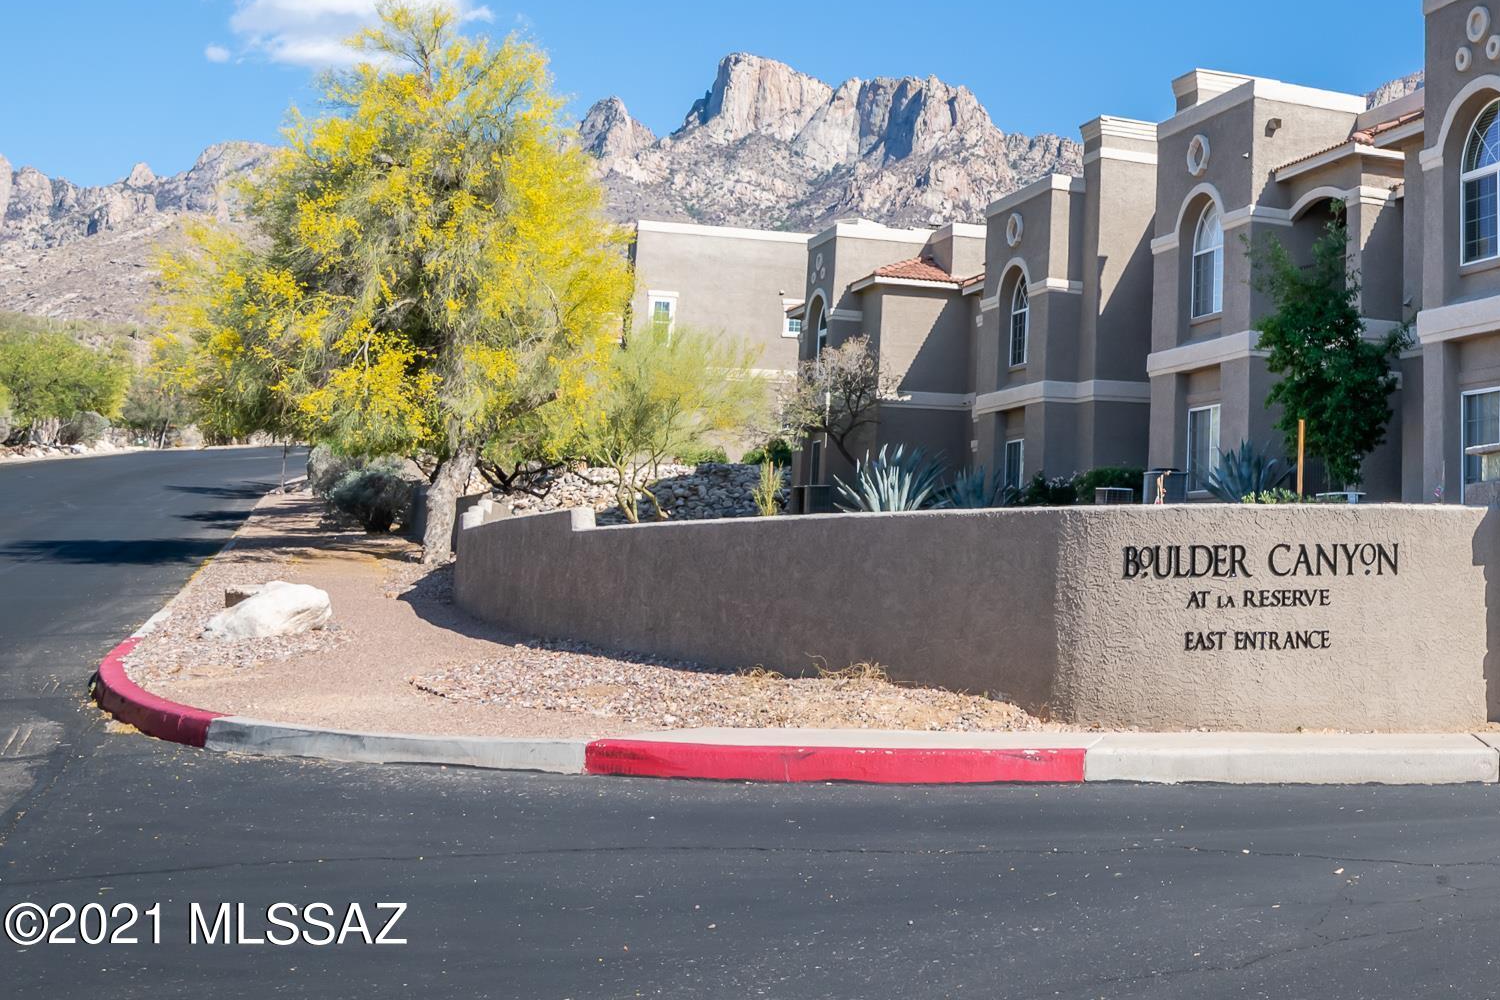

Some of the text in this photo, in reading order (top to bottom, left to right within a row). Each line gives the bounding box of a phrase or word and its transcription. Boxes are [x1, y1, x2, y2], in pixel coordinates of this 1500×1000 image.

[1122, 543, 1399, 578] BOULDER CANYON
[1186, 590, 1211, 609] AT
[1242, 589, 1331, 608] RESERVE
[1184, 630, 1331, 650] EAST ENTRANCE
